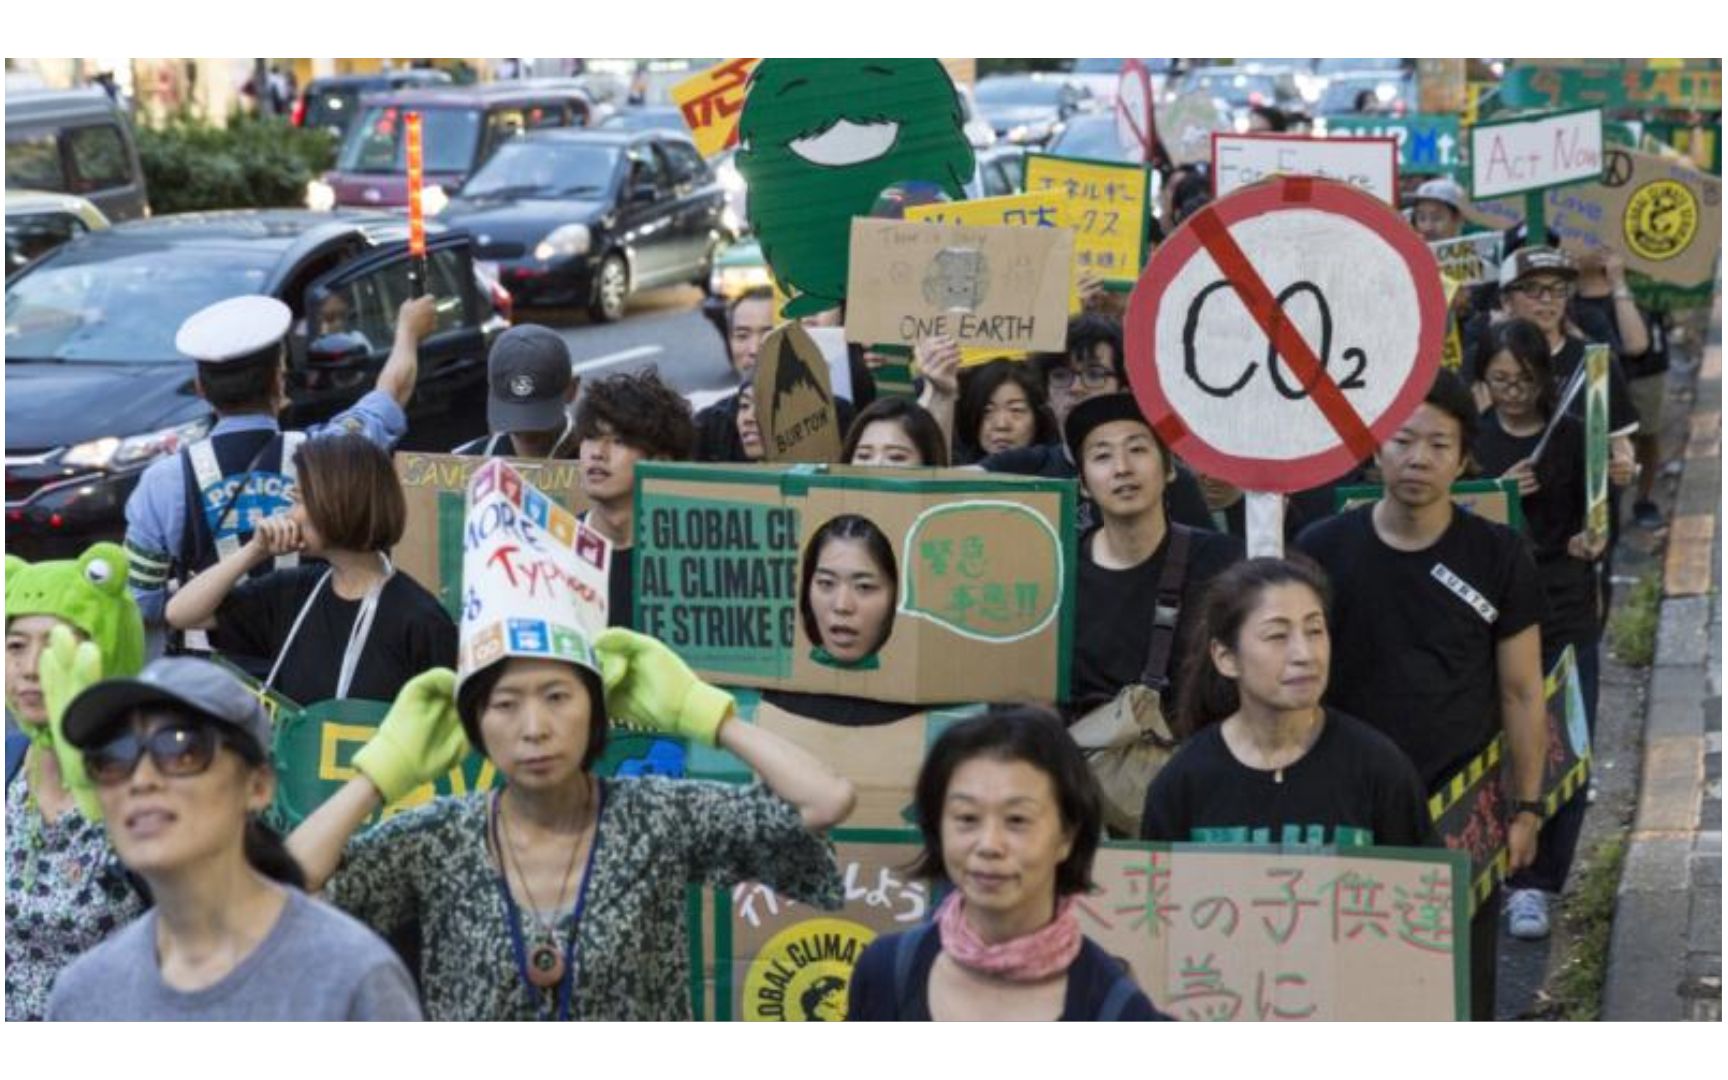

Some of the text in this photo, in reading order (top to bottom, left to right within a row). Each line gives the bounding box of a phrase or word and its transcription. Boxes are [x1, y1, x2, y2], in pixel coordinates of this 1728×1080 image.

[901, 313, 1035, 342] ONE EARTH
[774, 407, 829, 454] BURTON
[207, 476, 297, 508] POLICE
[652, 507, 760, 551] GLOBAL
[641, 555, 674, 598] AL
[671, 604, 773, 649] STRIKE
[785, 932, 868, 970] CLIMA
